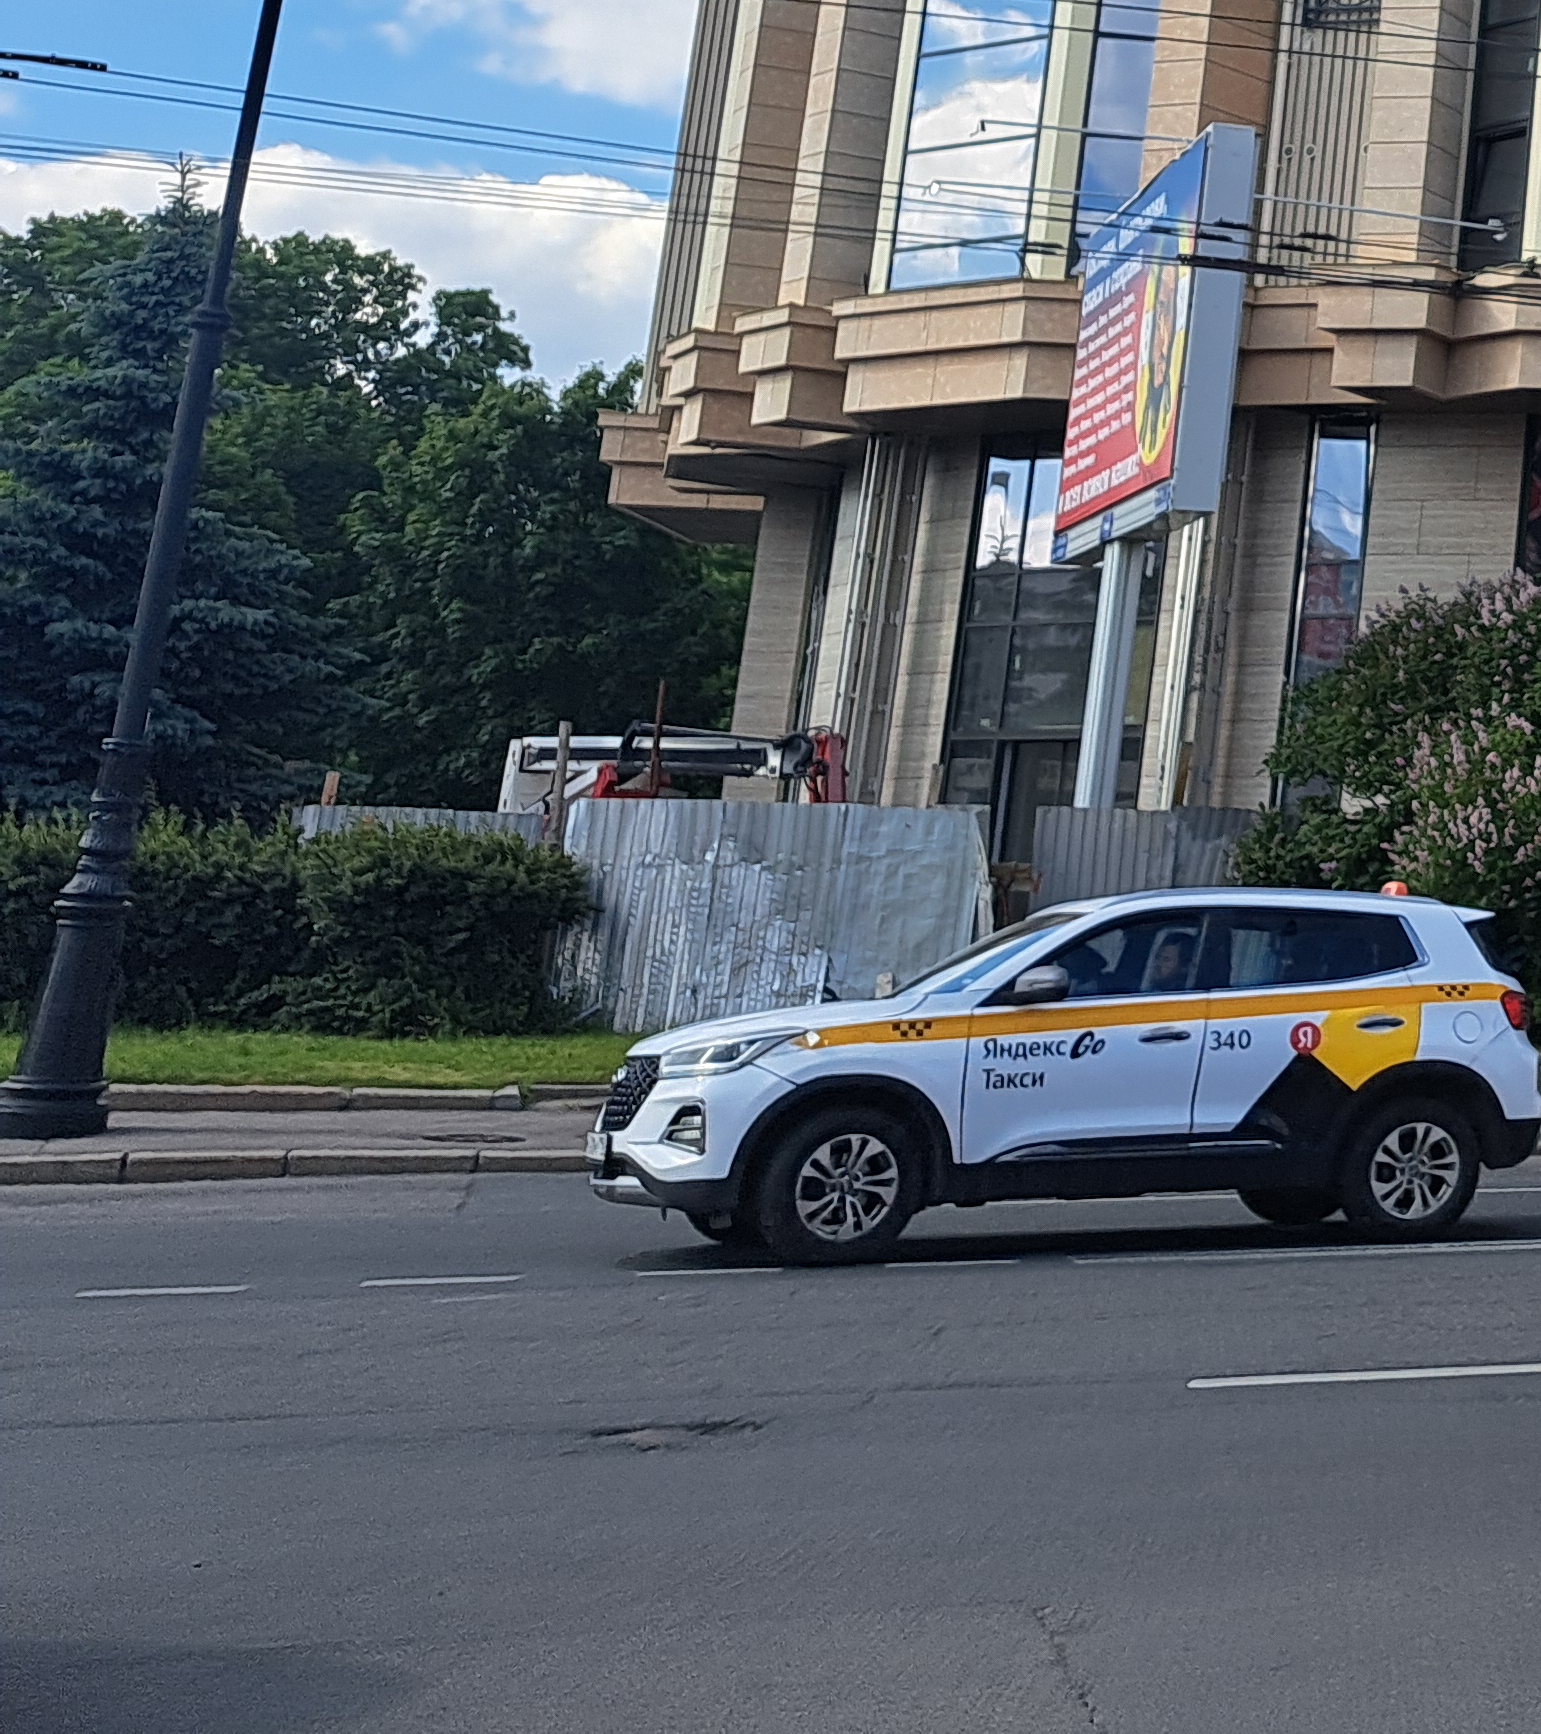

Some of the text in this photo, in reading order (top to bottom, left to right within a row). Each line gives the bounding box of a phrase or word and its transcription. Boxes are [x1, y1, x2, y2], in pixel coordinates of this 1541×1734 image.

[982, 1030, 1107, 1062] Яндекс Go
[1208, 1029, 1252, 1051] 340
[1297, 1025, 1313, 1049] Я
[981, 1067, 1046, 1090] Такси
